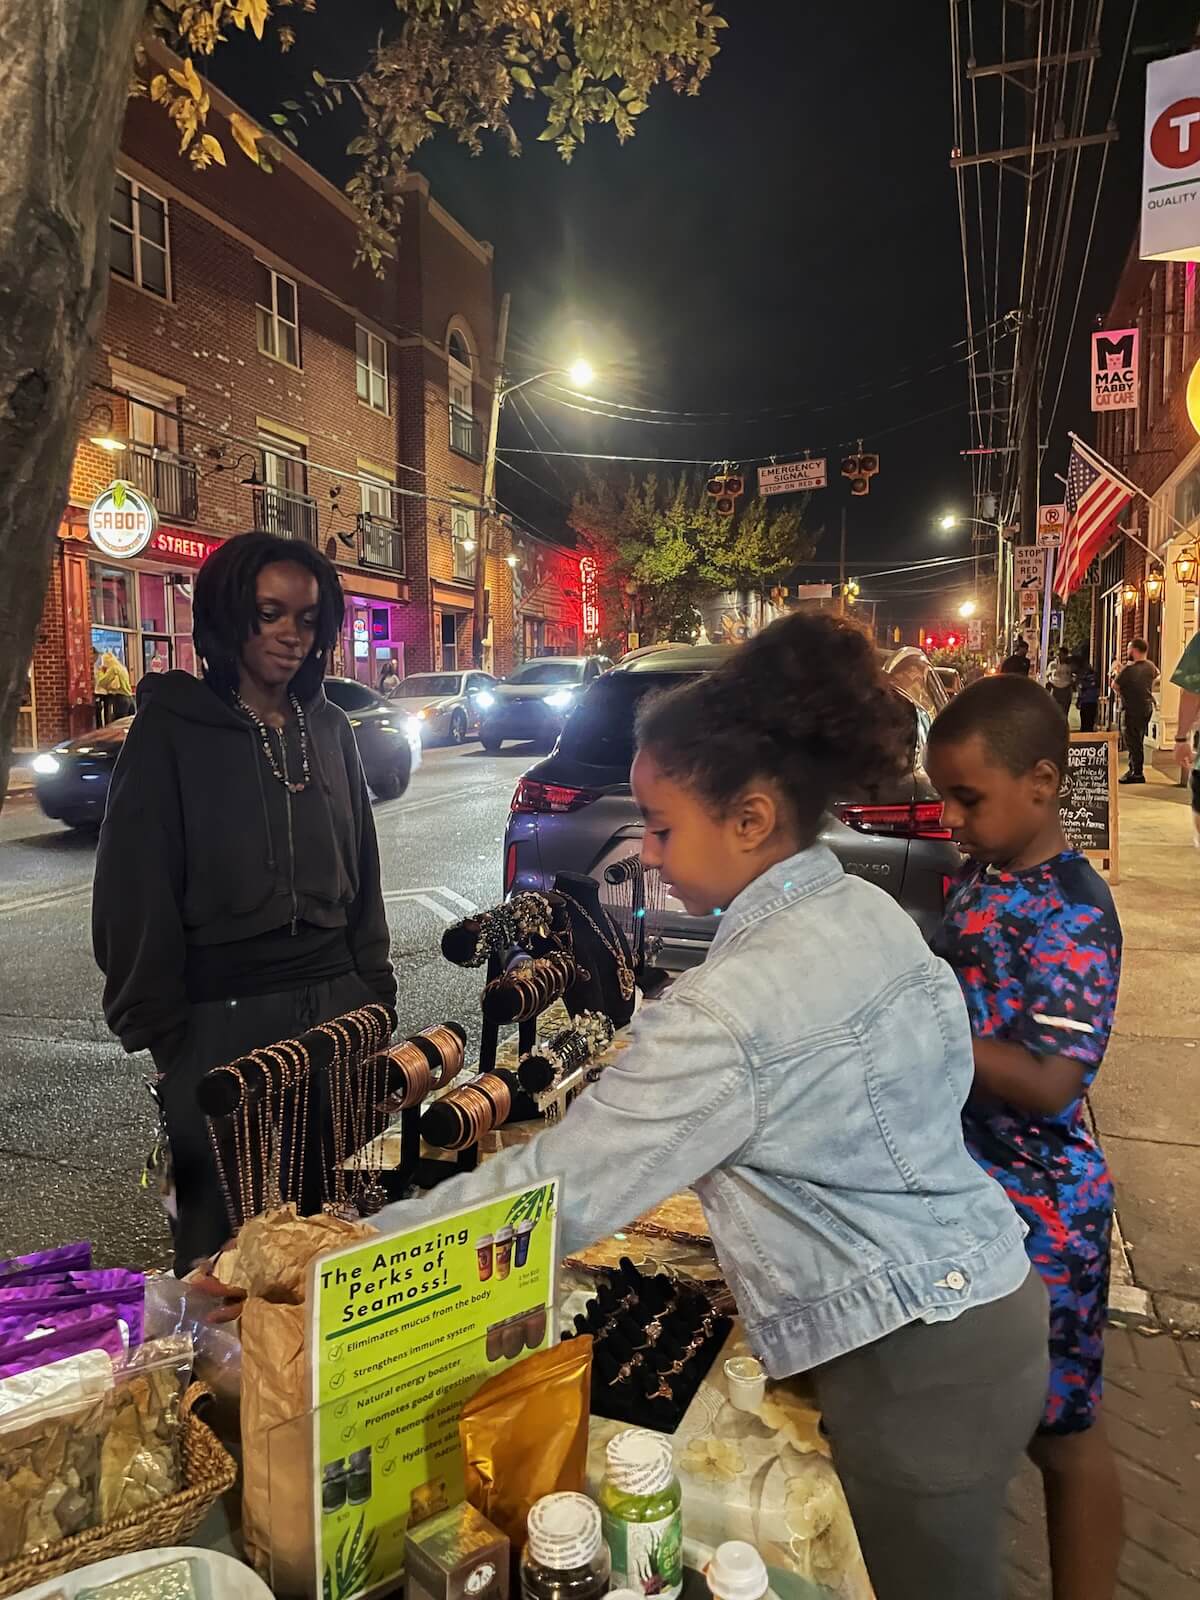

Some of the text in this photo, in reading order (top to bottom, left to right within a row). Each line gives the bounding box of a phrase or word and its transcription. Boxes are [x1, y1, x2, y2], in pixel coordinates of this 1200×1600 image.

[1147, 191, 1198, 210] QUALITY
[1096, 370, 1134, 385] MAC
[1096, 382, 1134, 394] TABBY
[1096, 393, 1112, 406] CAT
[761, 462, 823, 478] EMERGENCY
[774, 472, 810, 482] SIGNAL
[764, 484, 783, 493] STOP
[93, 512, 146, 530] SABOR
[157, 534, 206, 559] STREET
[1018, 549, 1040, 558] STOP
[1020, 566, 1038, 575] RED
[1068, 747, 1096, 757] ooms
[321, 1229, 470, 1290] The Amazing
[349, 1251, 445, 1300] Perks of
[342, 1269, 449, 1323] Seamoss!
[401, 1315, 430, 1332] mucus
[432, 1306, 453, 1319] from
[455, 1299, 470, 1310] the
[471, 1290, 492, 1303] body
[353, 1323, 476, 1378] Strengthens immune system
[357, 1359, 462, 1408] Natural energy booster
[365, 1373, 476, 1428] Promotes good digestion
[395, 1412, 435, 1436] Removes
[402, 1439, 441, 1463] Hydrates
